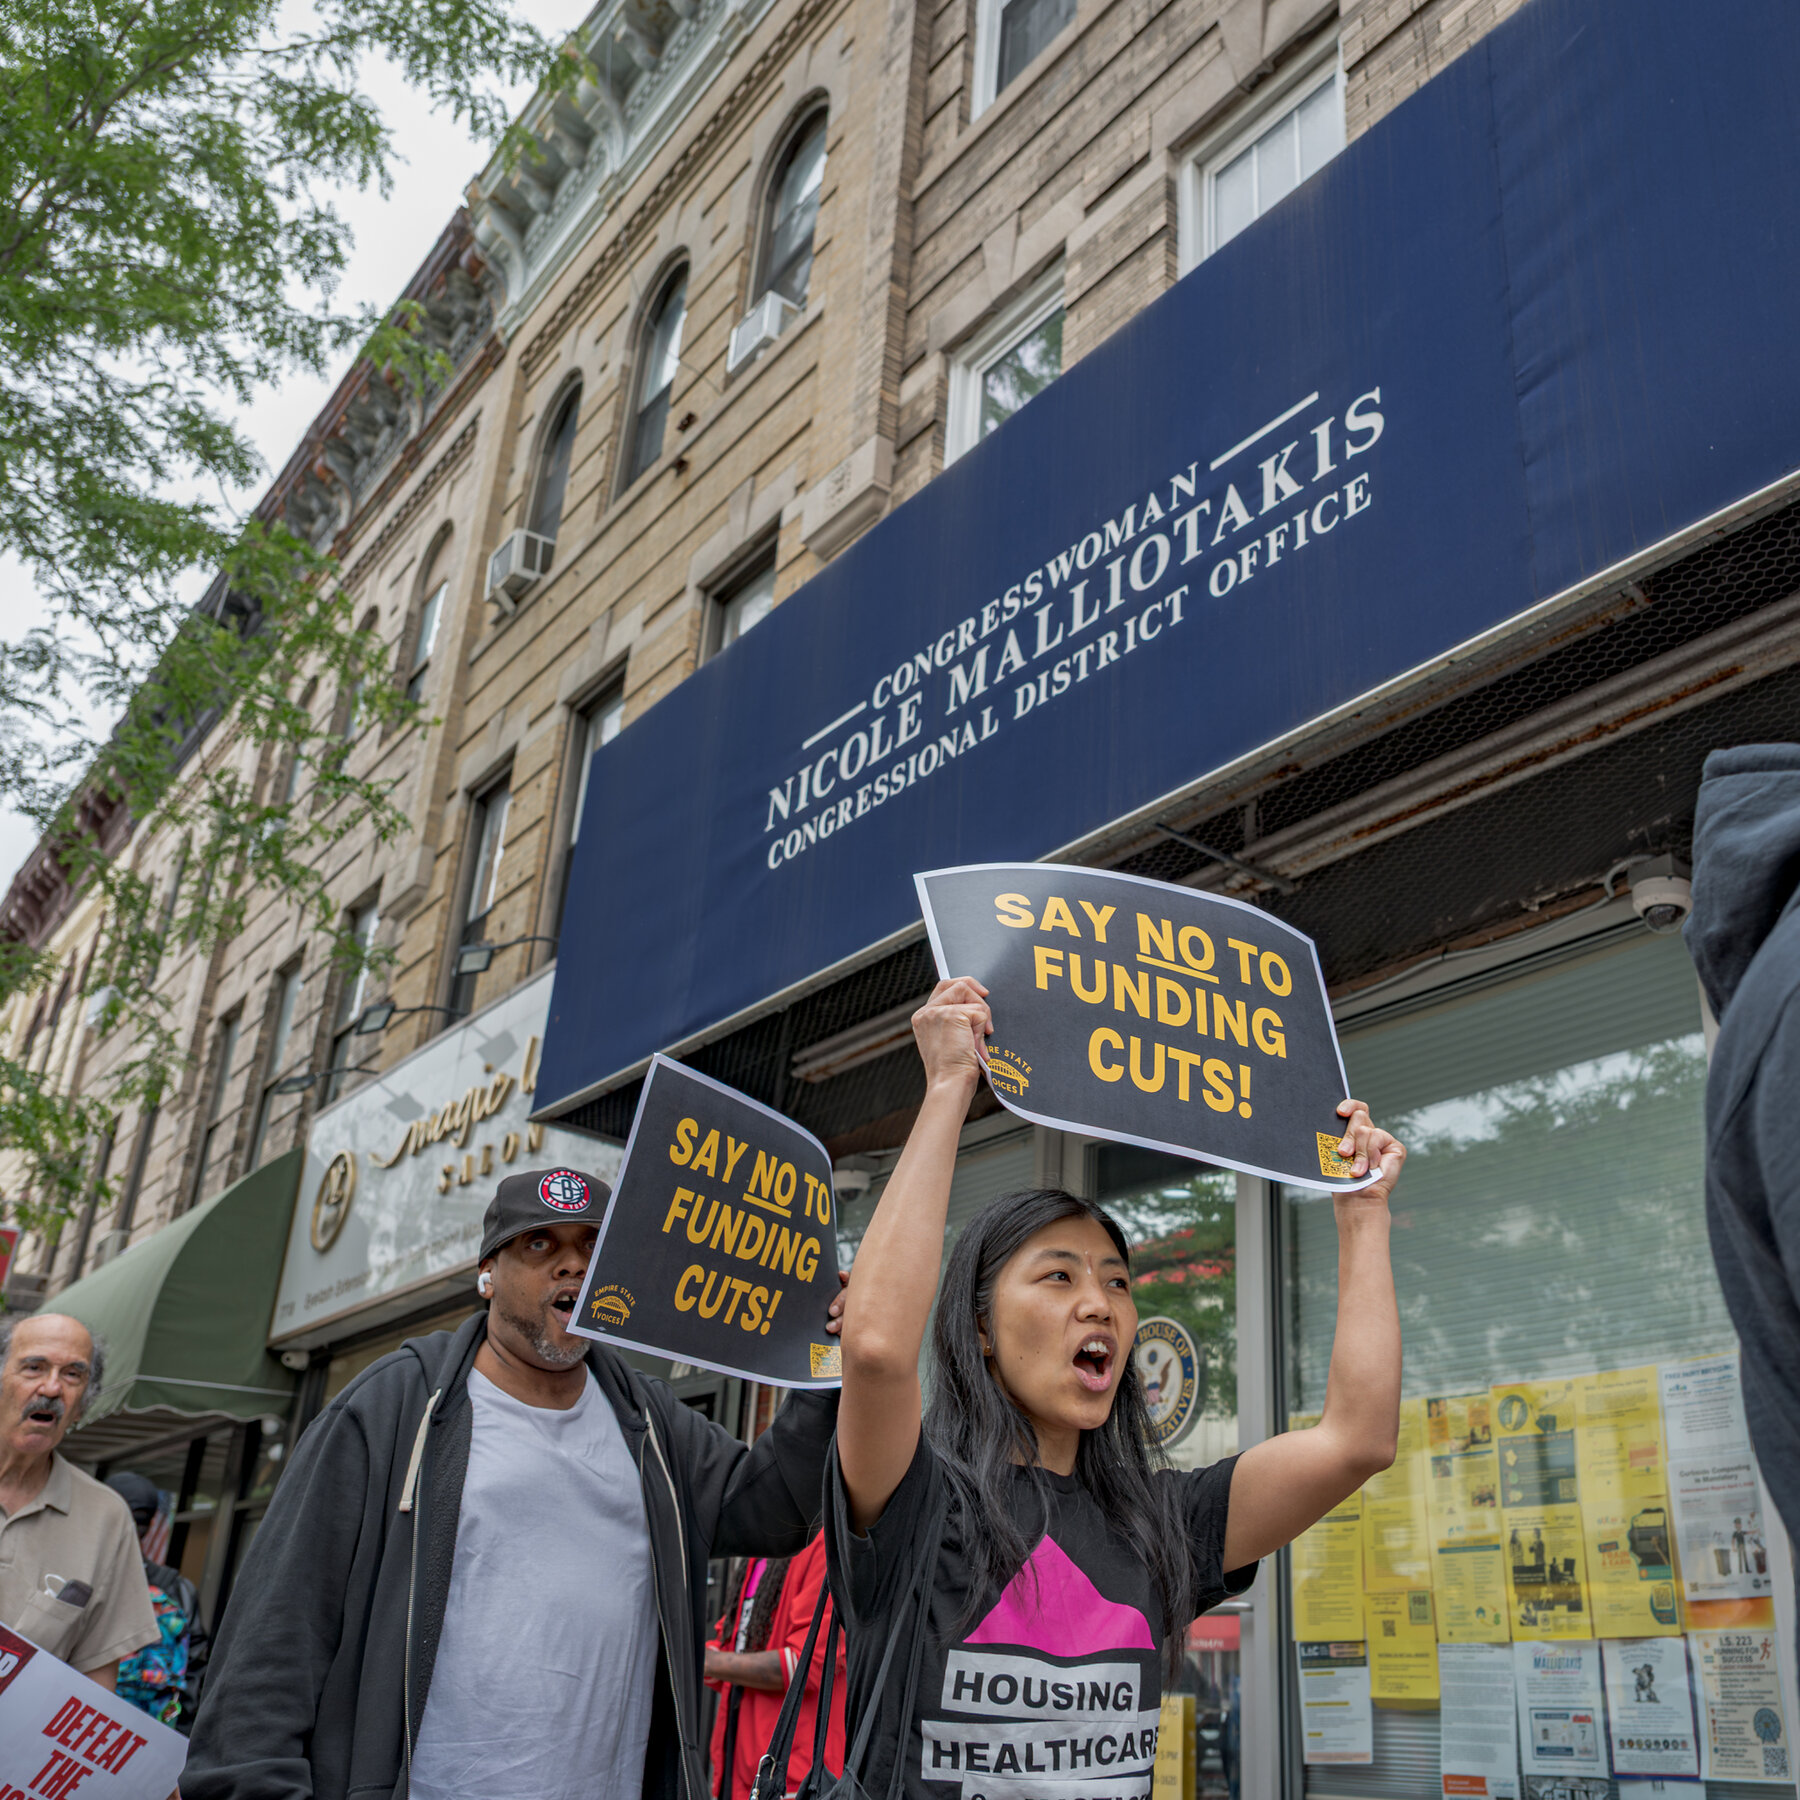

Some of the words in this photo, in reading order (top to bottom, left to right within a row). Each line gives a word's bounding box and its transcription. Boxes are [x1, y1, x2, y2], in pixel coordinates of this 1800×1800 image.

[765, 691, 922, 831] NICOLE
[946, 386, 1385, 716] MALLIOTAKIS
[871, 461, 1198, 710] CONGRESSWOMAN
[766, 710, 999, 871] CONGRESSIONAL
[1013, 585, 1190, 721] DISTRICT
[1208, 473, 1373, 598] OFFICE
[994, 892, 1117, 944] SAY
[1136, 912, 1216, 972] NO
[1227, 937, 1293, 998] TO
[1033, 945, 1287, 1059] FUNDING
[991, 1077, 1018, 1094] OICES
[1003, 1049, 1033, 1075] STATE
[1087, 1027, 1253, 1120] CUTS!
[368, 1062, 515, 1169] magic
[437, 1122, 545, 1195] SALON
[561, 1179, 574, 1200] B
[669, 1117, 749, 1184] SAY
[747, 1149, 797, 1208] NO
[803, 1171, 831, 1226] TO
[661, 1186, 821, 1284] FUNDING
[594, 1284, 619, 1297] EMPIRE
[620, 1287, 637, 1308] STATE
[596, 1311, 621, 1325] VOICES
[674, 1264, 784, 1336] CUTS!
[1138, 1324, 1178, 1344] HOUSE
[1175, 1337, 1192, 1360] OF
[952, 1670, 1134, 1712] HOUSING
[41, 1695, 149, 1776] DEFEAT
[28, 1749, 95, 1800] THE
